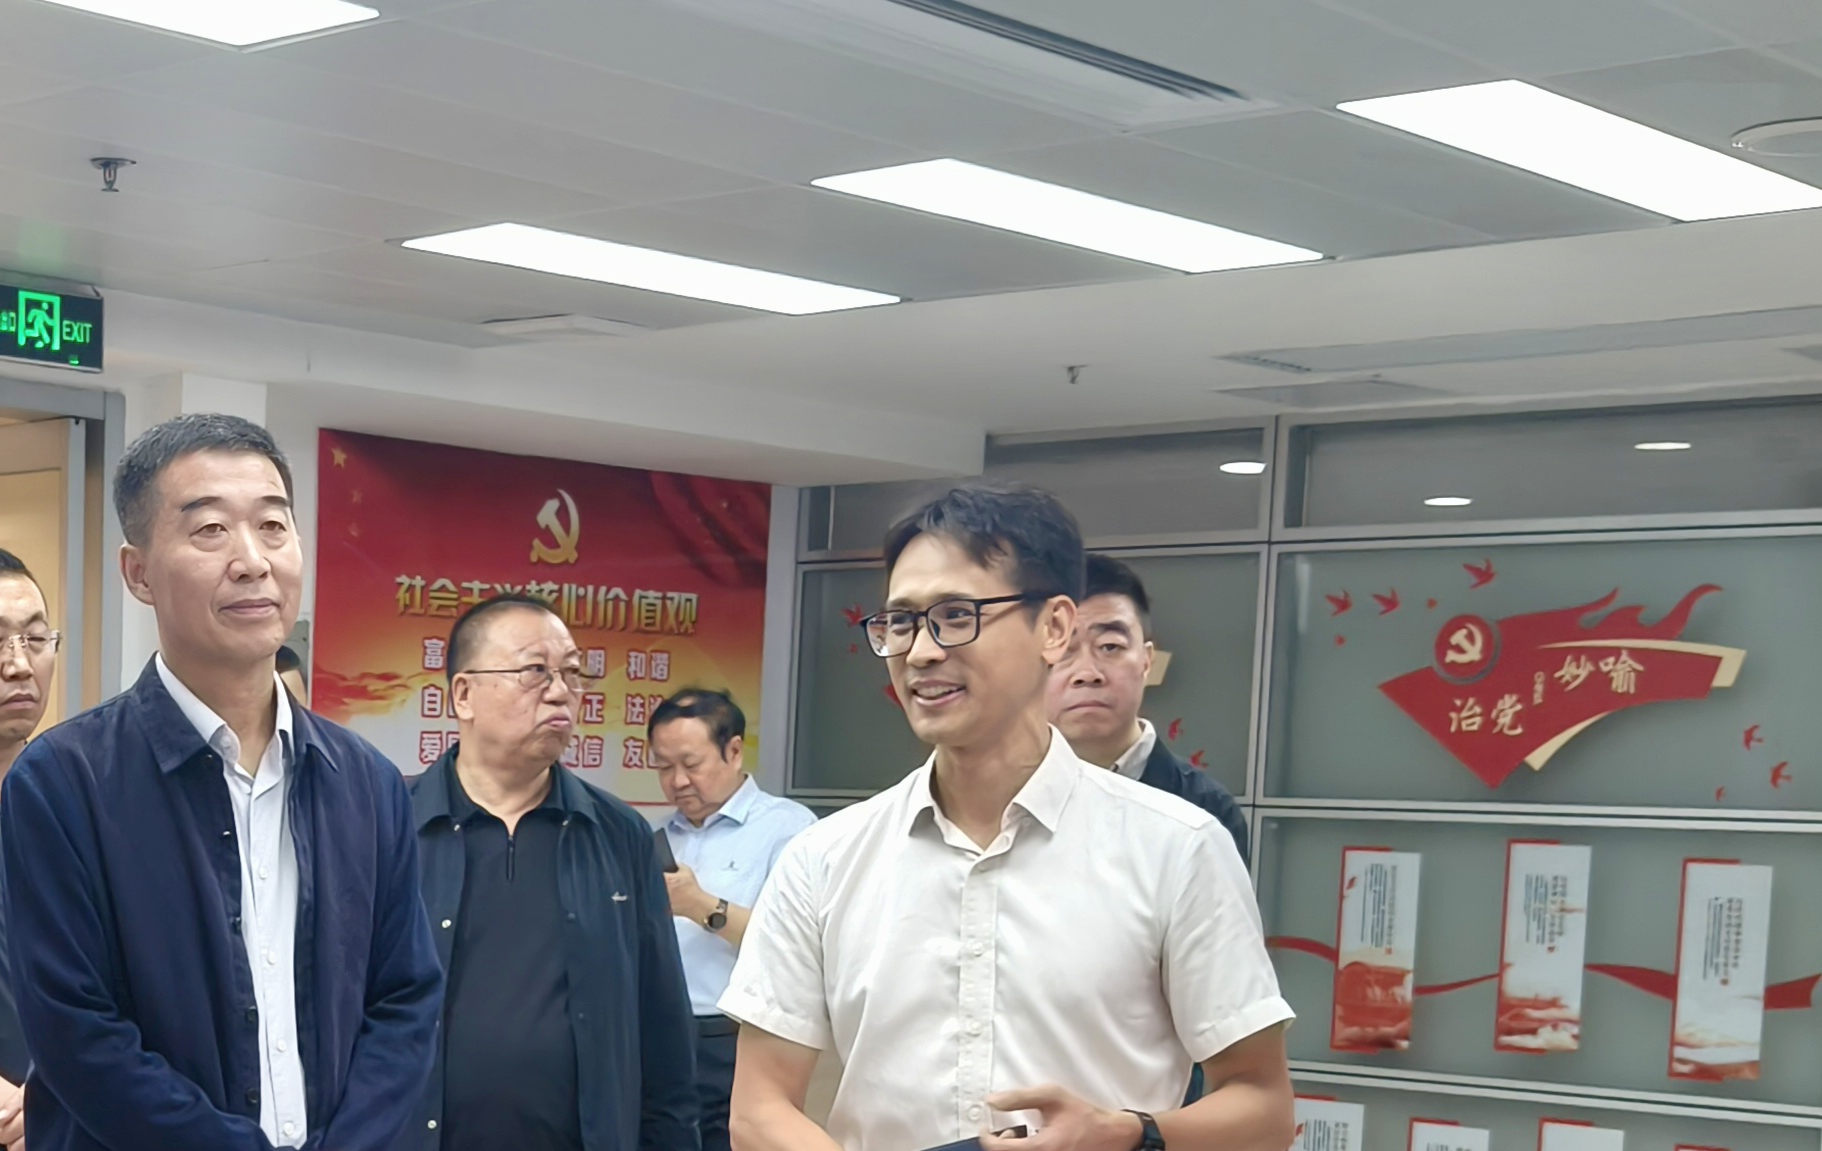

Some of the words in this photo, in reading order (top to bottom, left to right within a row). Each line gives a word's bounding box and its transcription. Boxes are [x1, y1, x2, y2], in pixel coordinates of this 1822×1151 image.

[62, 320, 93, 343] EXIT
[577, 647, 605, 678] 明
[626, 649, 670, 681] 和谐
[421, 684, 457, 719] 自
[577, 692, 605, 724] 正
[1448, 693, 1524, 736] 治党
[622, 736, 660, 770] 友
